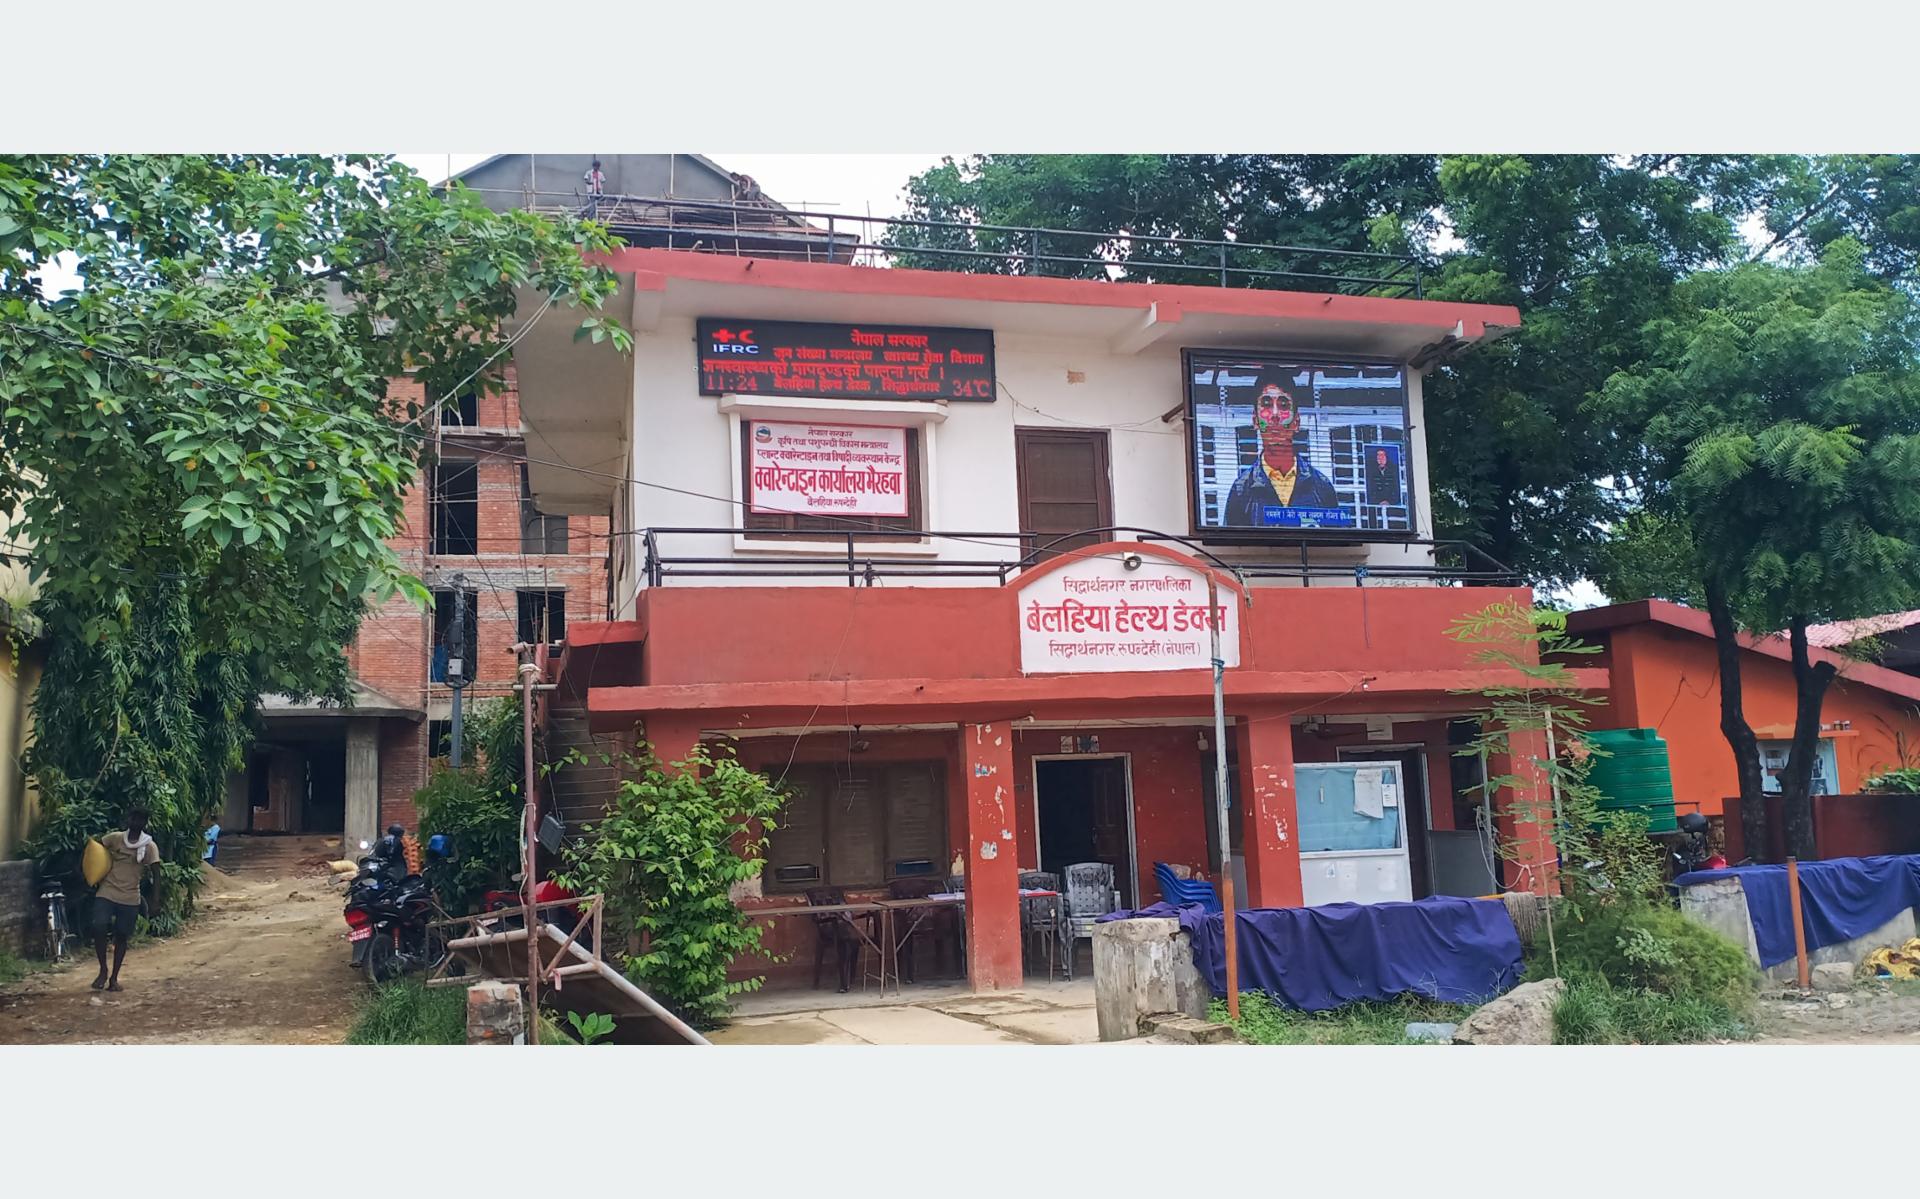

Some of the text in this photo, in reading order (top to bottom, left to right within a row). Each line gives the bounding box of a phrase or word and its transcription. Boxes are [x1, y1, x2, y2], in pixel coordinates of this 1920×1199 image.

[713, 344, 759, 354] IFRC
[707, 375, 758, 391] 11:24
[819, 465, 866, 494] कार्यालय
[866, 465, 902, 494] भैरहवा
[1130, 576, 1191, 592] नगरपालिका
[1026, 598, 1111, 633] बेलहिया
[1114, 599, 1168, 632] हेल्थ
